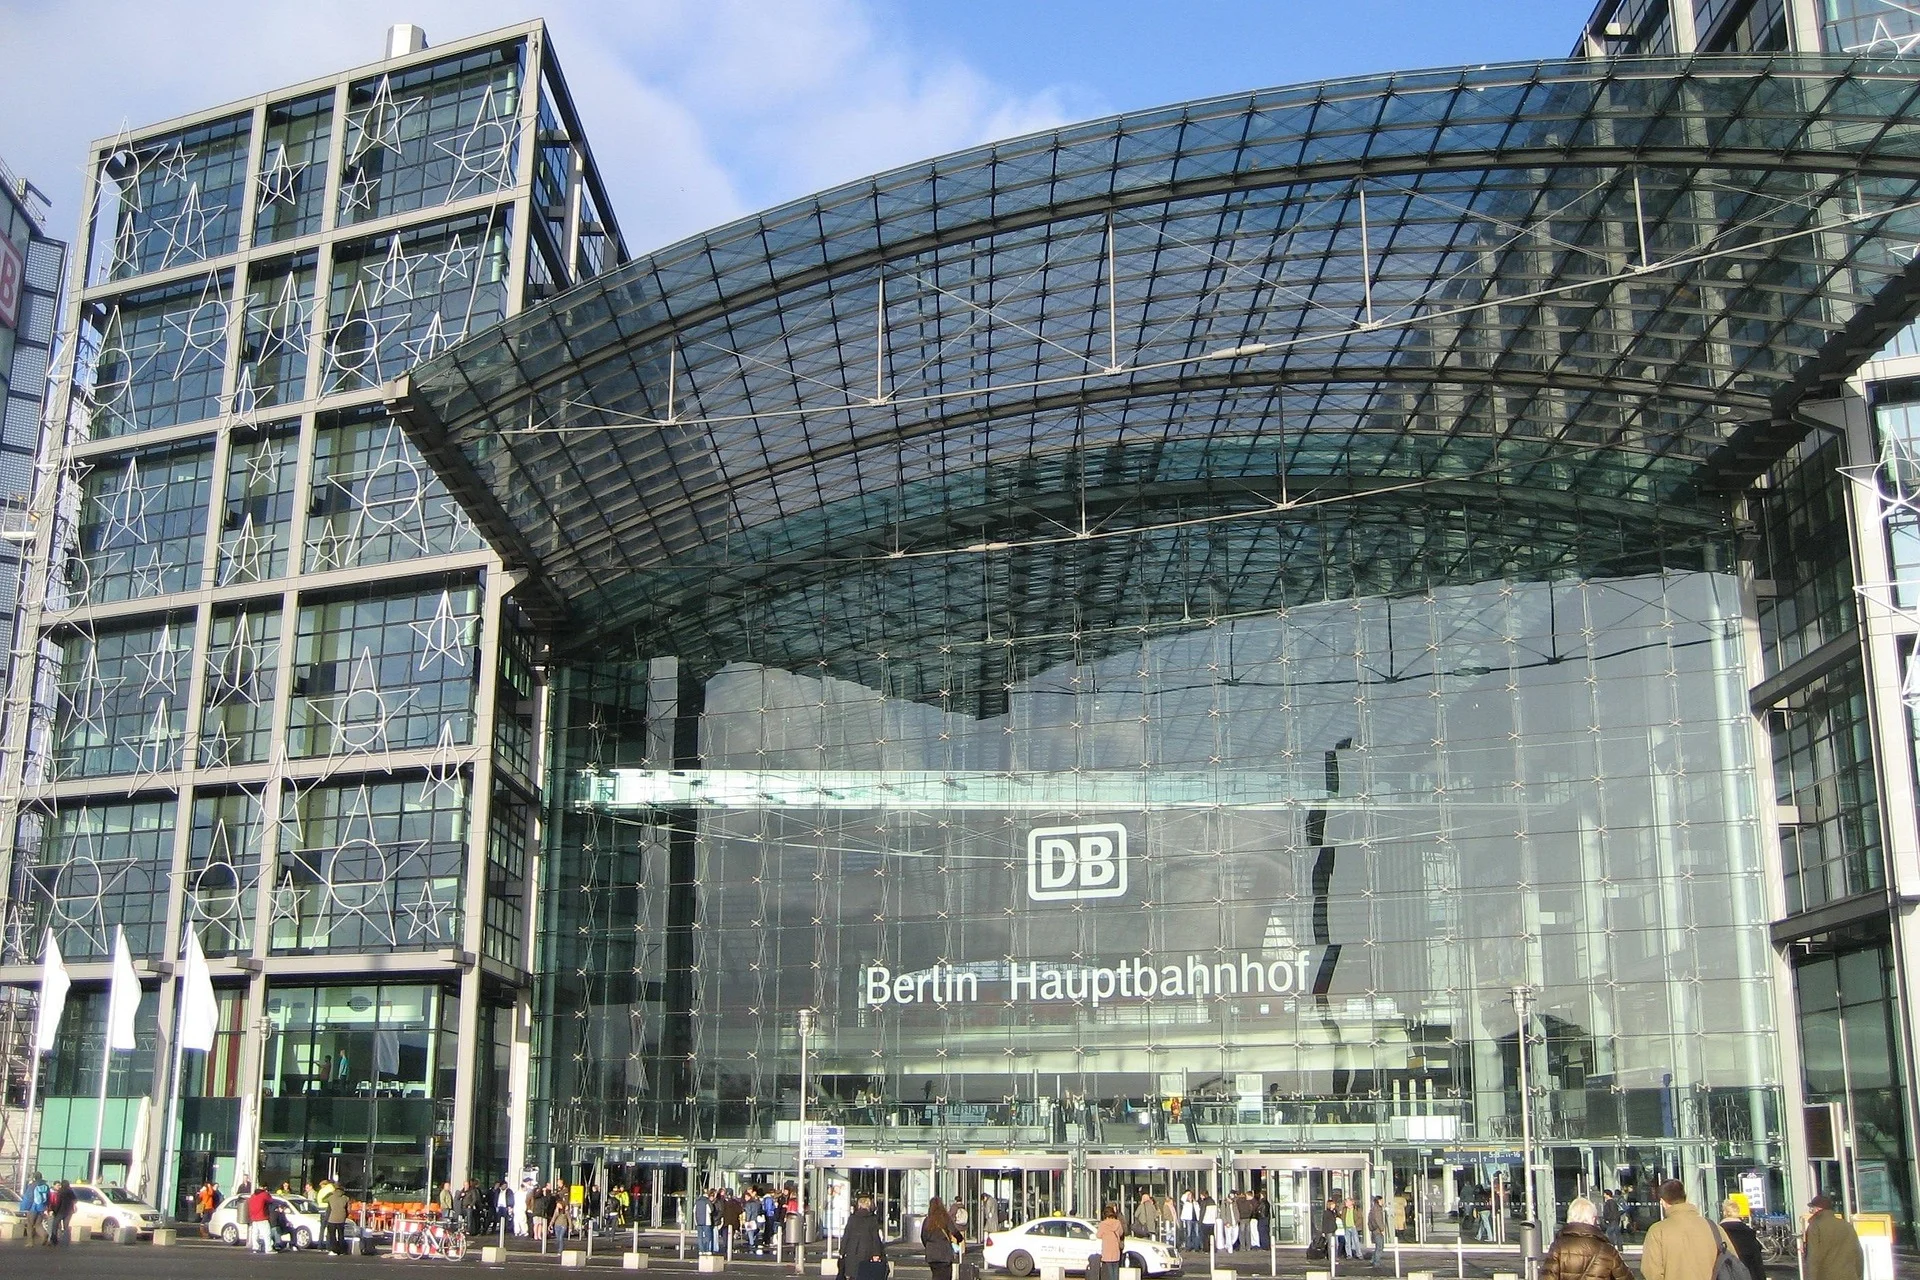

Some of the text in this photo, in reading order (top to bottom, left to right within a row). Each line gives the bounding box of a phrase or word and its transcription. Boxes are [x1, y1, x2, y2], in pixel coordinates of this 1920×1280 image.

[1041, 837, 1115, 888] DB
[866, 952, 1309, 1007] Berlin Hauptbahnhof
